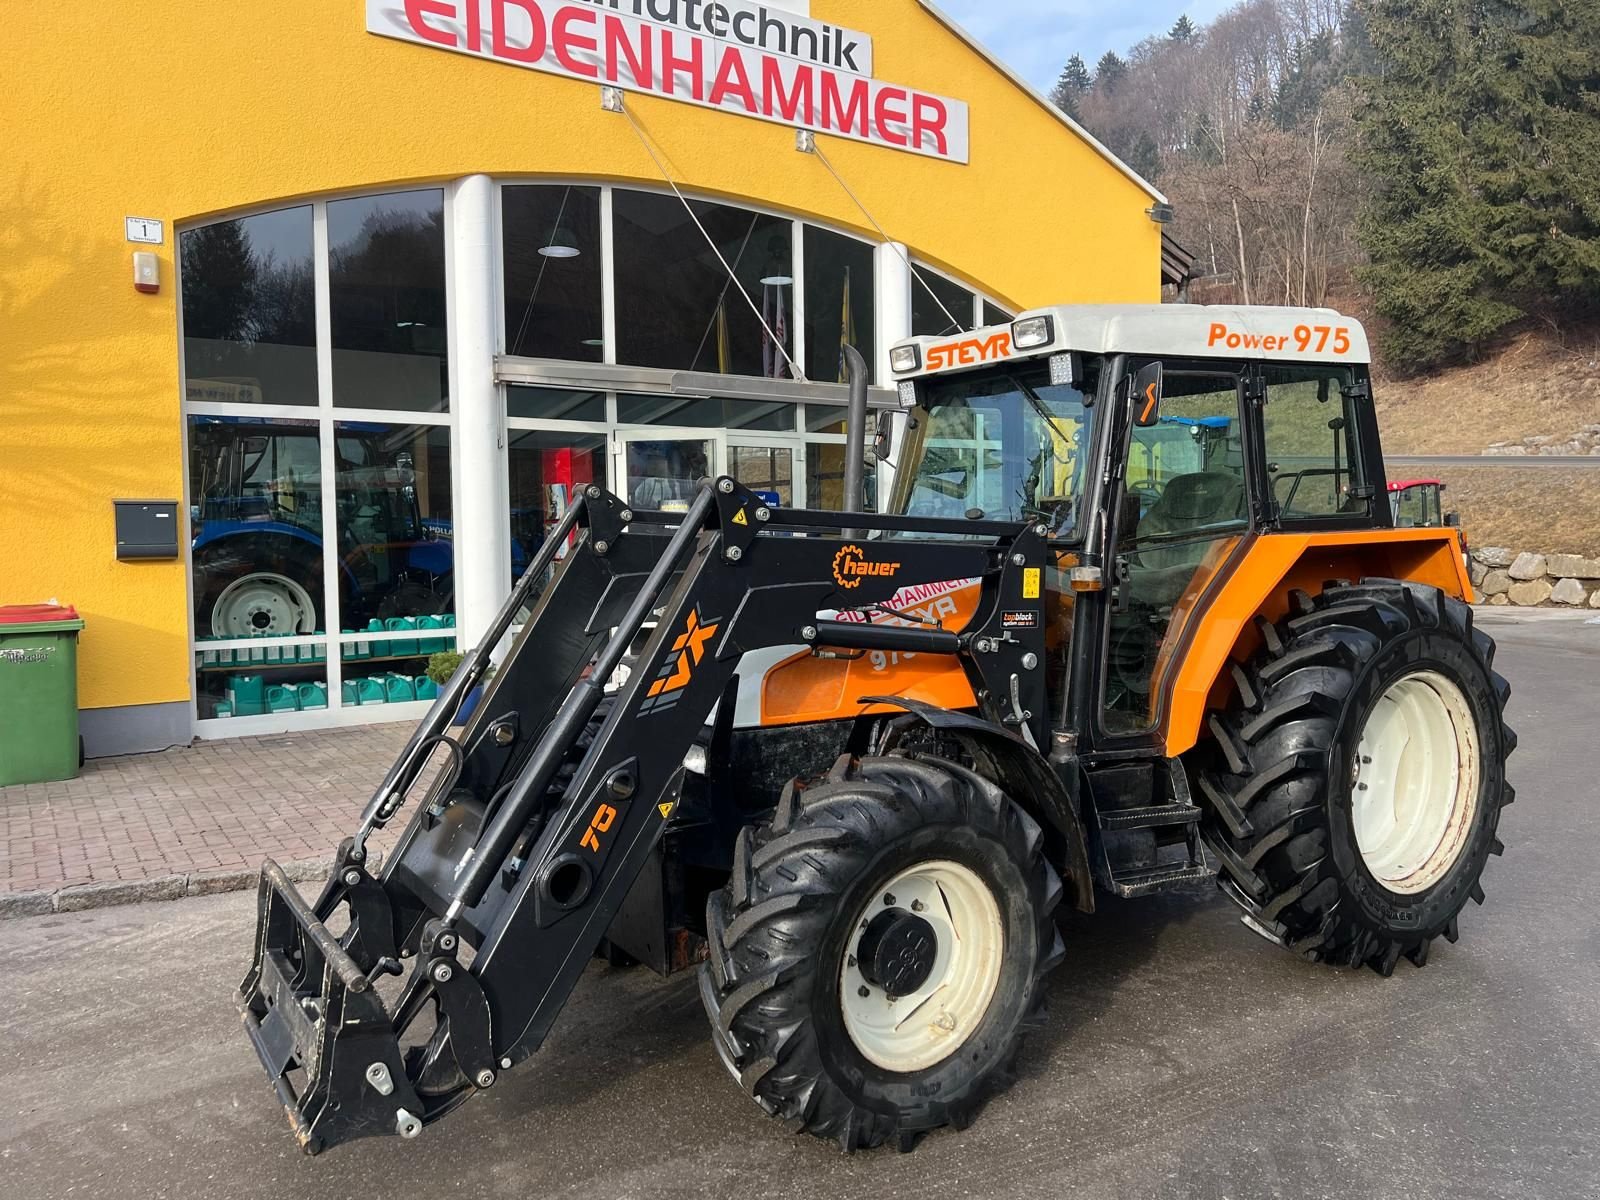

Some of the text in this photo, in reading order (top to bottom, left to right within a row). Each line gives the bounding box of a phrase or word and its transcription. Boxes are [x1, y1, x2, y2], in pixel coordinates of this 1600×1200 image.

[583, 0, 859, 72] dtechnik
[404, 0, 947, 155] EIDENHAMMER
[142, 224, 147, 237] 1
[925, 332, 1011, 371] STEYR
[1207, 322, 1351, 355] Power 975
[843, 554, 901, 576] hauer
[1003, 613, 1033, 621] topblock
[580, 803, 617, 853] 70
